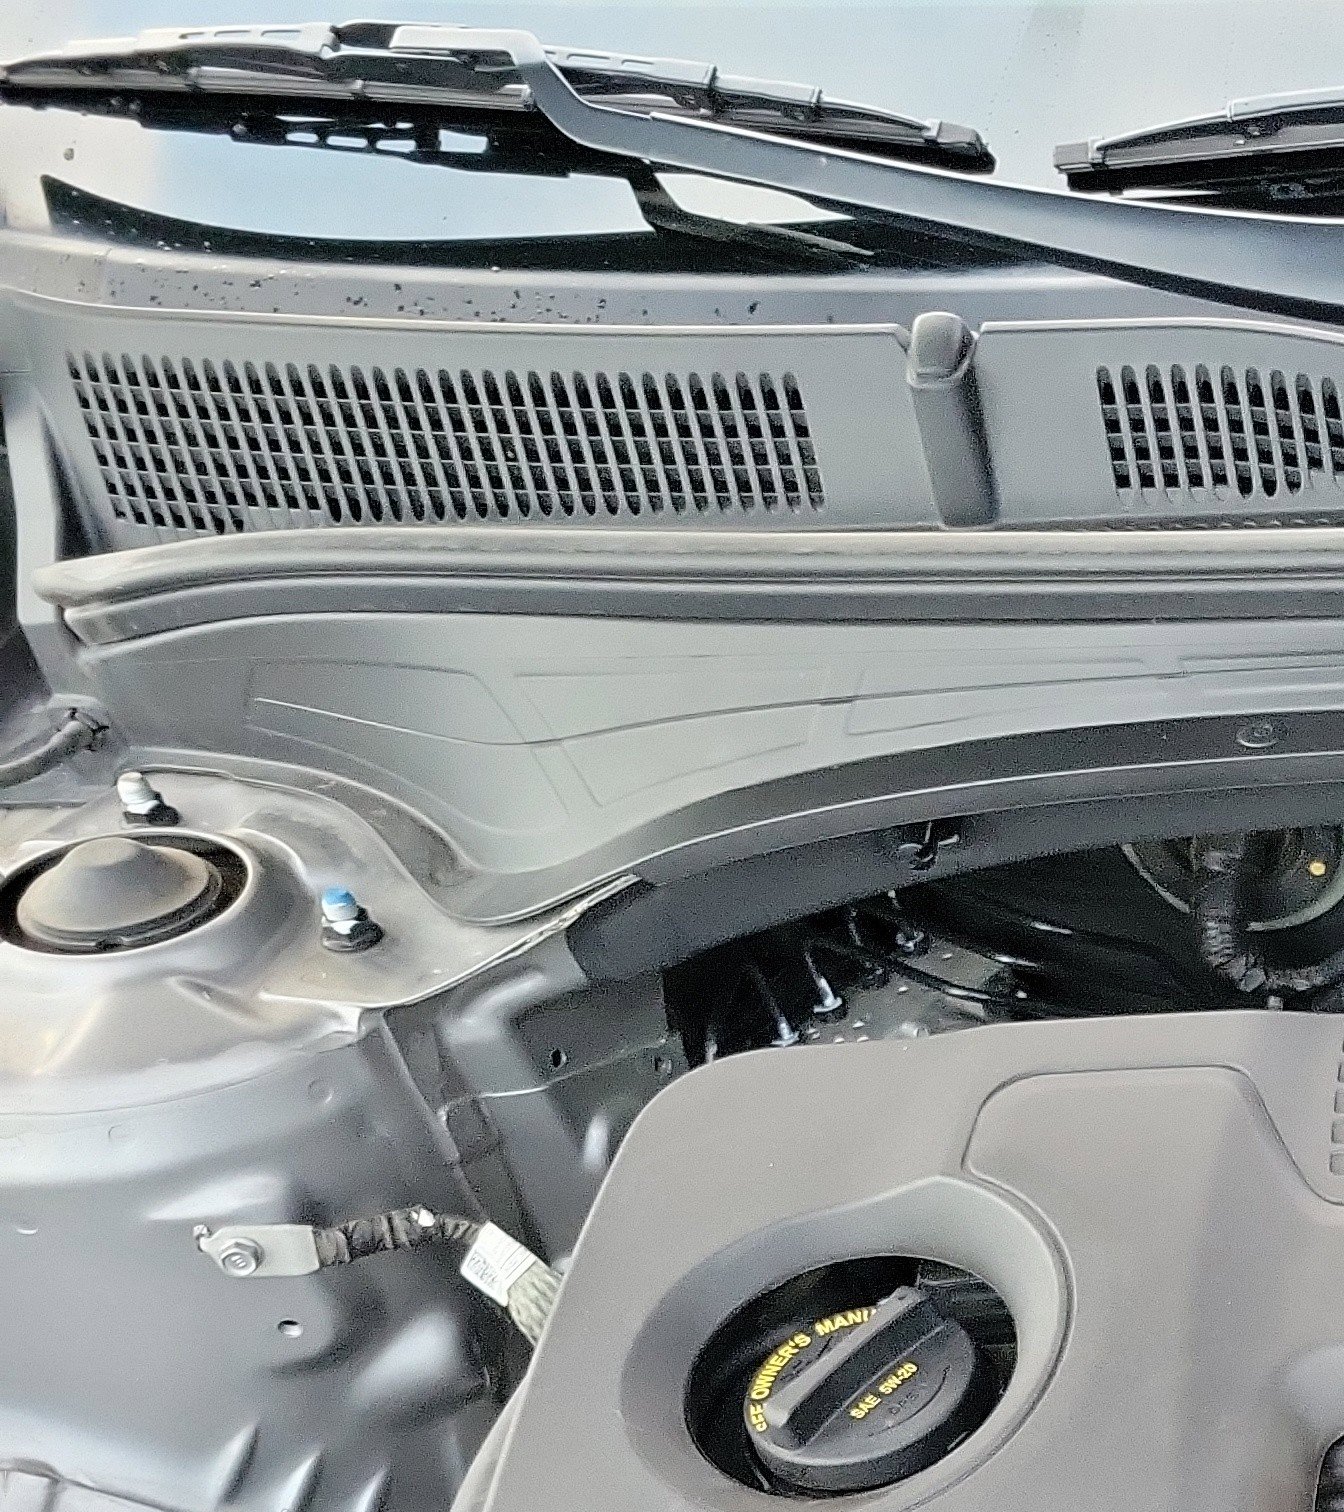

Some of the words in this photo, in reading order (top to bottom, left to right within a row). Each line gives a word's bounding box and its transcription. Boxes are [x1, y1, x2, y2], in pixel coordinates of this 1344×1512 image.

[751, 1332, 812, 1400] OWNER'S
[850, 1394, 882, 1420] SAE
[878, 1361, 919, 1396] 5W-20
